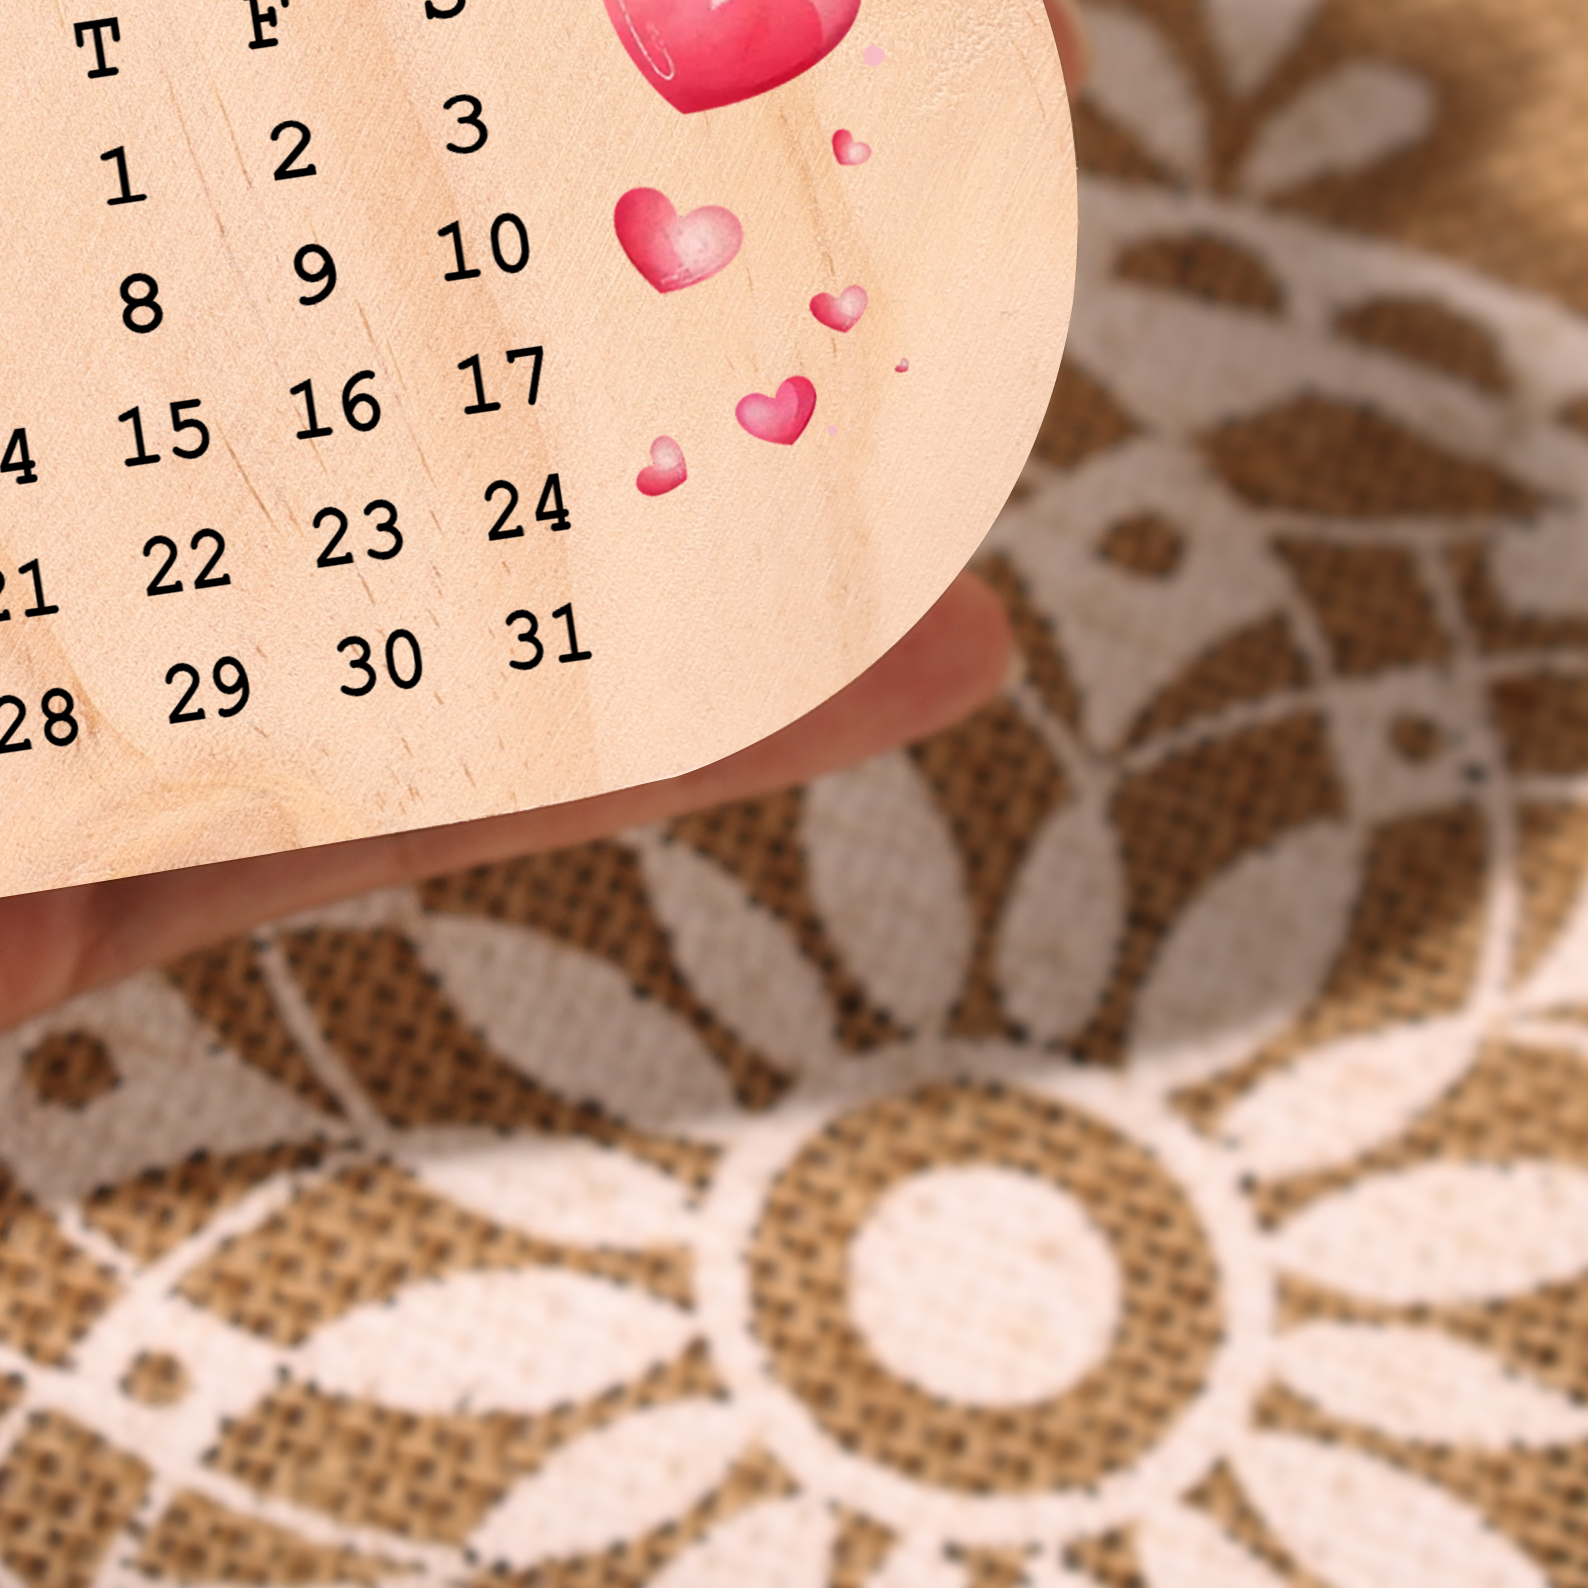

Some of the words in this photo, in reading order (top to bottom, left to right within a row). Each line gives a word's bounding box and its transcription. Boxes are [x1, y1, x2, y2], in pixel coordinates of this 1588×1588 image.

[71, 14, 122, 80] T
[98, 143, 149, 207] 1
[268, 118, 318, 182] 2
[441, 92, 489, 156] 3
[117, 270, 164, 335] 8
[291, 241, 338, 307] 9
[435, 210, 531, 283] 10
[116, 396, 211, 468] 15
[287, 367, 382, 441] 16
[455, 343, 545, 416] 17
[141, 526, 232, 598] 22
[310, 497, 405, 569] 23
[482, 471, 572, 543] 24
[163, 653, 251, 725] 29
[334, 626, 424, 698] 30
[503, 600, 594, 672] 31
